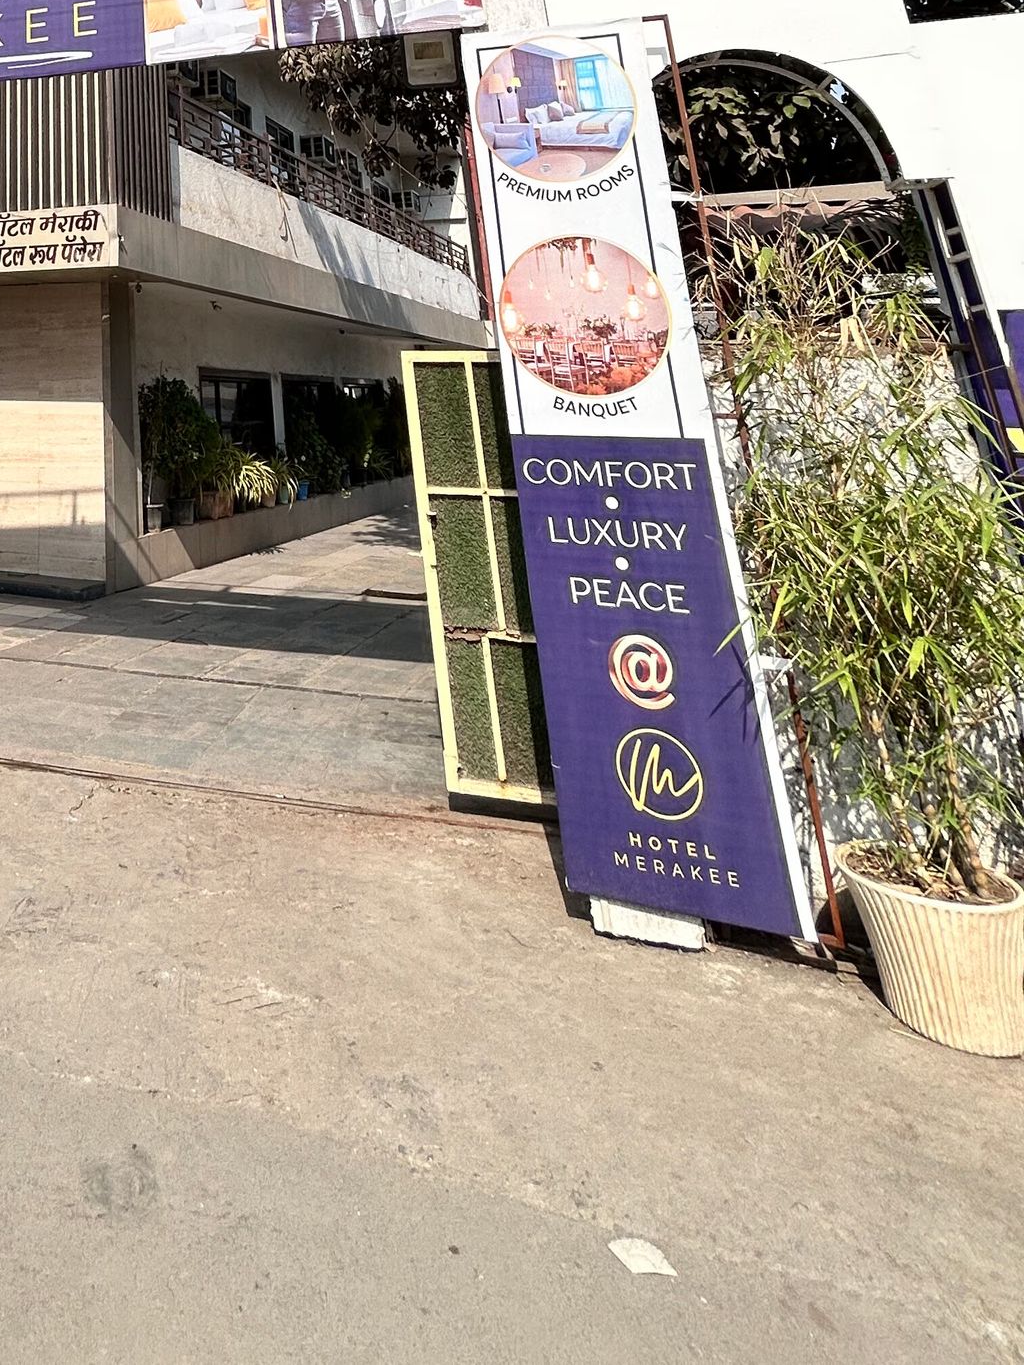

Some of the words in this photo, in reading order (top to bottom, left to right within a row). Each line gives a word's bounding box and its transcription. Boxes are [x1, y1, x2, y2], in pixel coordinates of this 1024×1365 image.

[496, 172, 573, 203] PREMIUM
[575, 164, 635, 201] ROOMS
[28, 244, 59, 266] रूप
[552, 394, 640, 419] BANQUET
[522, 457, 697, 491] COMFORT
[547, 516, 688, 552] LUXURY
[569, 577, 691, 615] PEACE
[607, 633, 676, 711] @
[628, 831, 717, 861] HOTEL
[613, 850, 740, 889] MERAKEE
